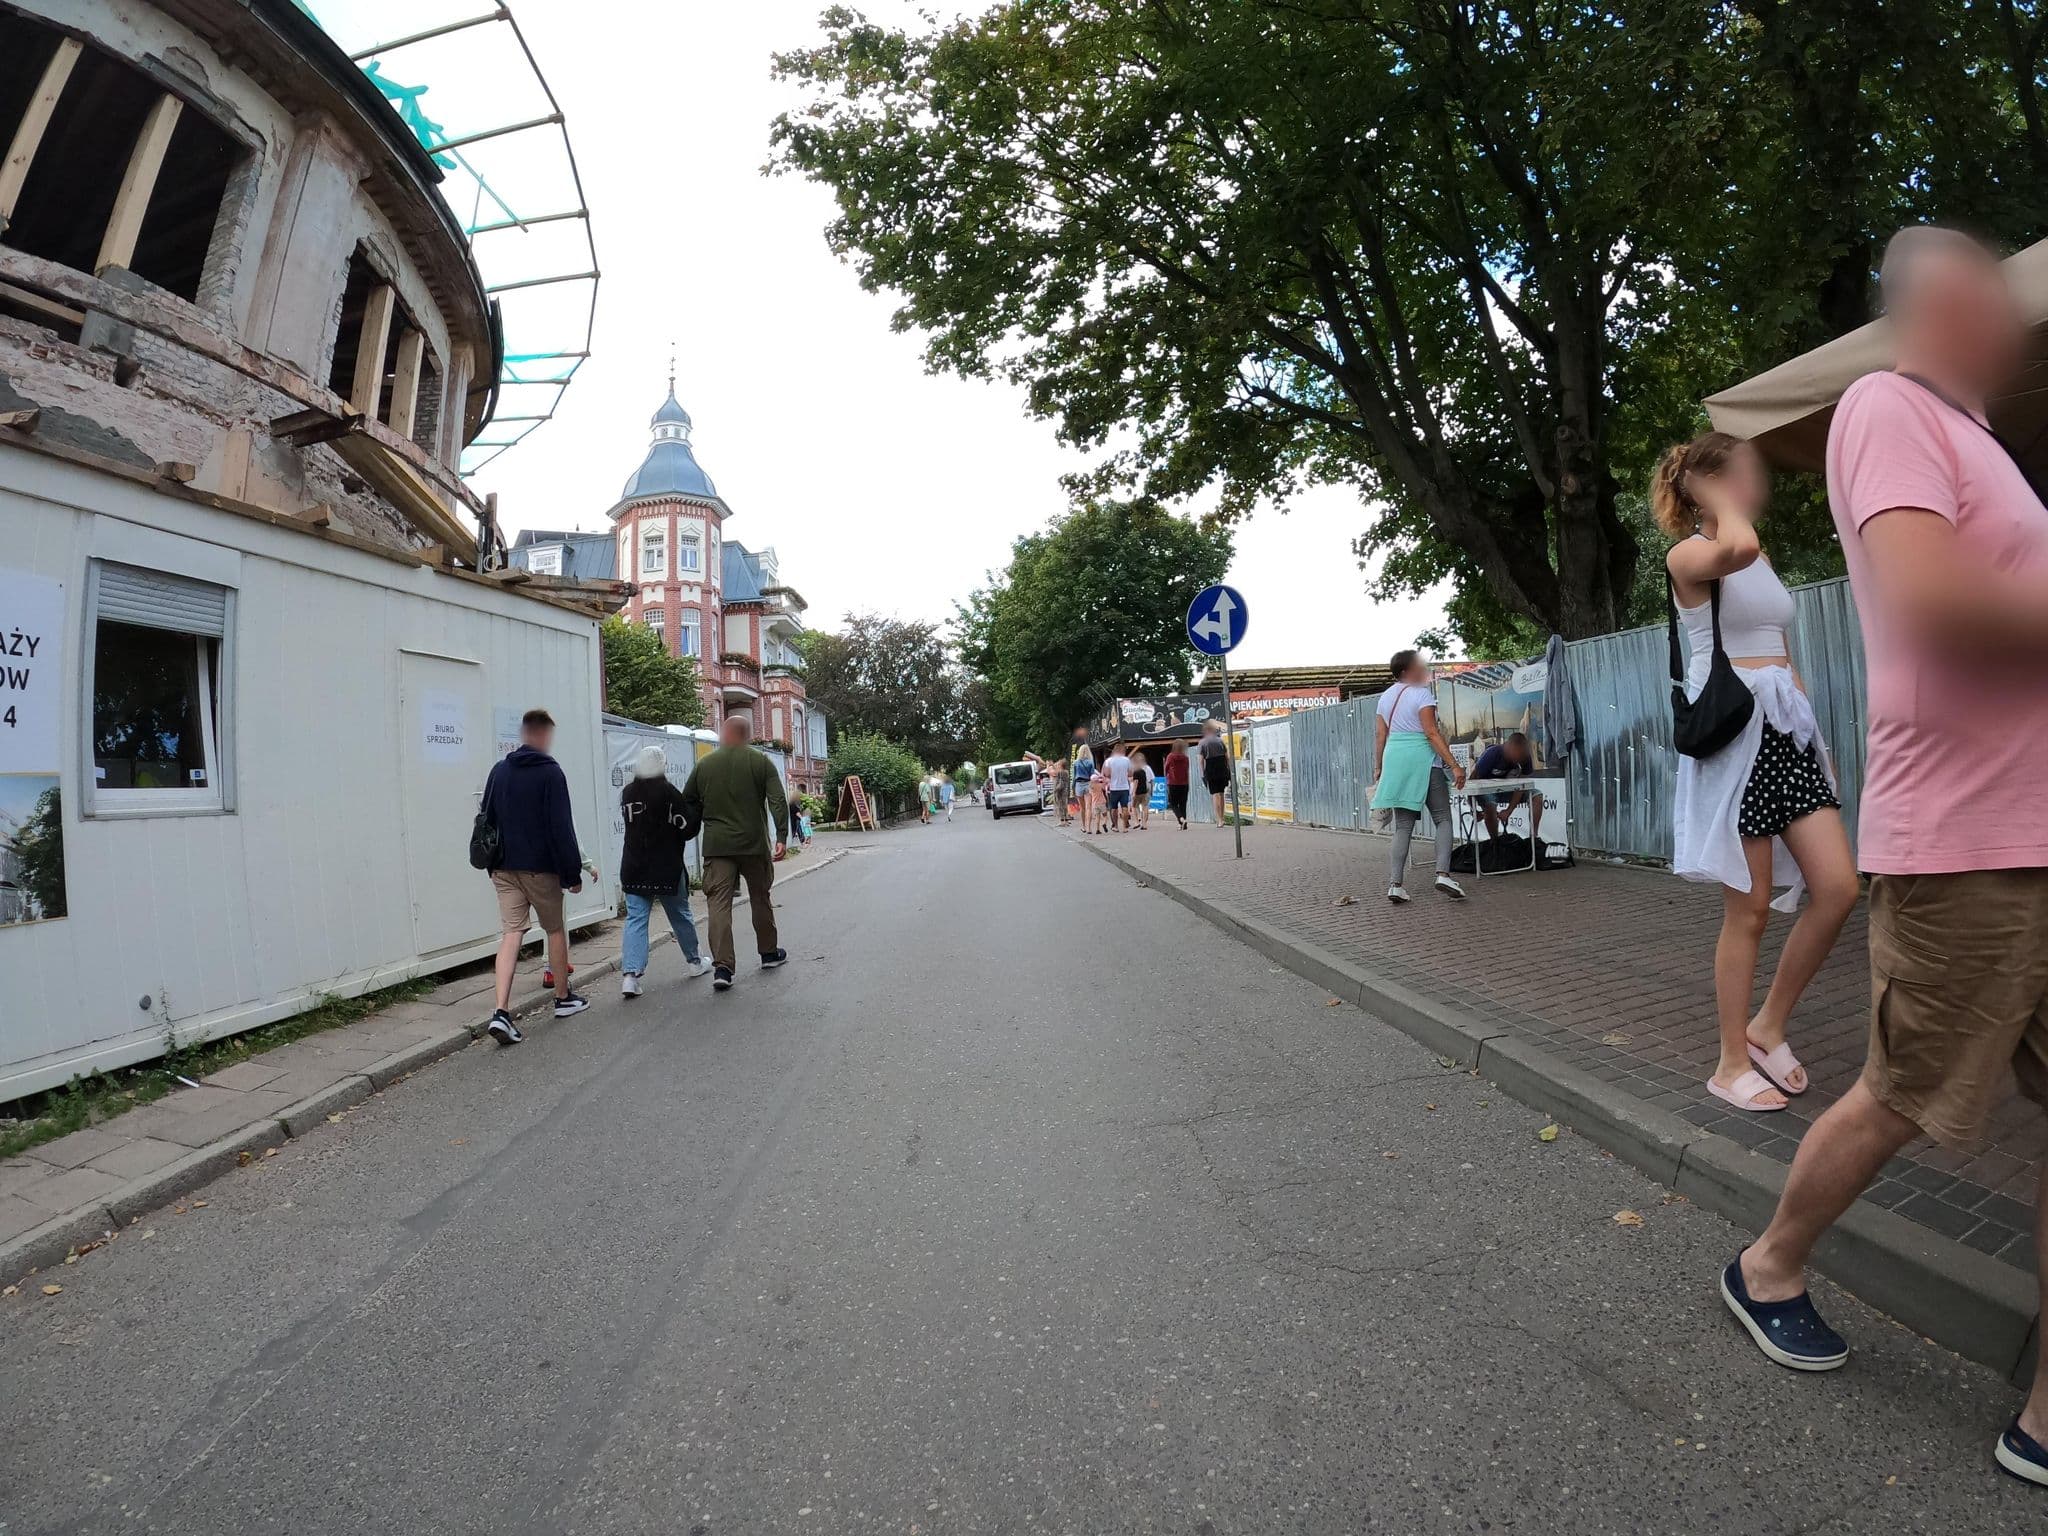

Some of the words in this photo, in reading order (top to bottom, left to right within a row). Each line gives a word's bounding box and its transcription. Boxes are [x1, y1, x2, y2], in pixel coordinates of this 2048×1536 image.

[1273, 697, 1325, 709] DESPERADOS
[3, 704, 17, 728] 4
[434, 724, 455, 734] BIURO
